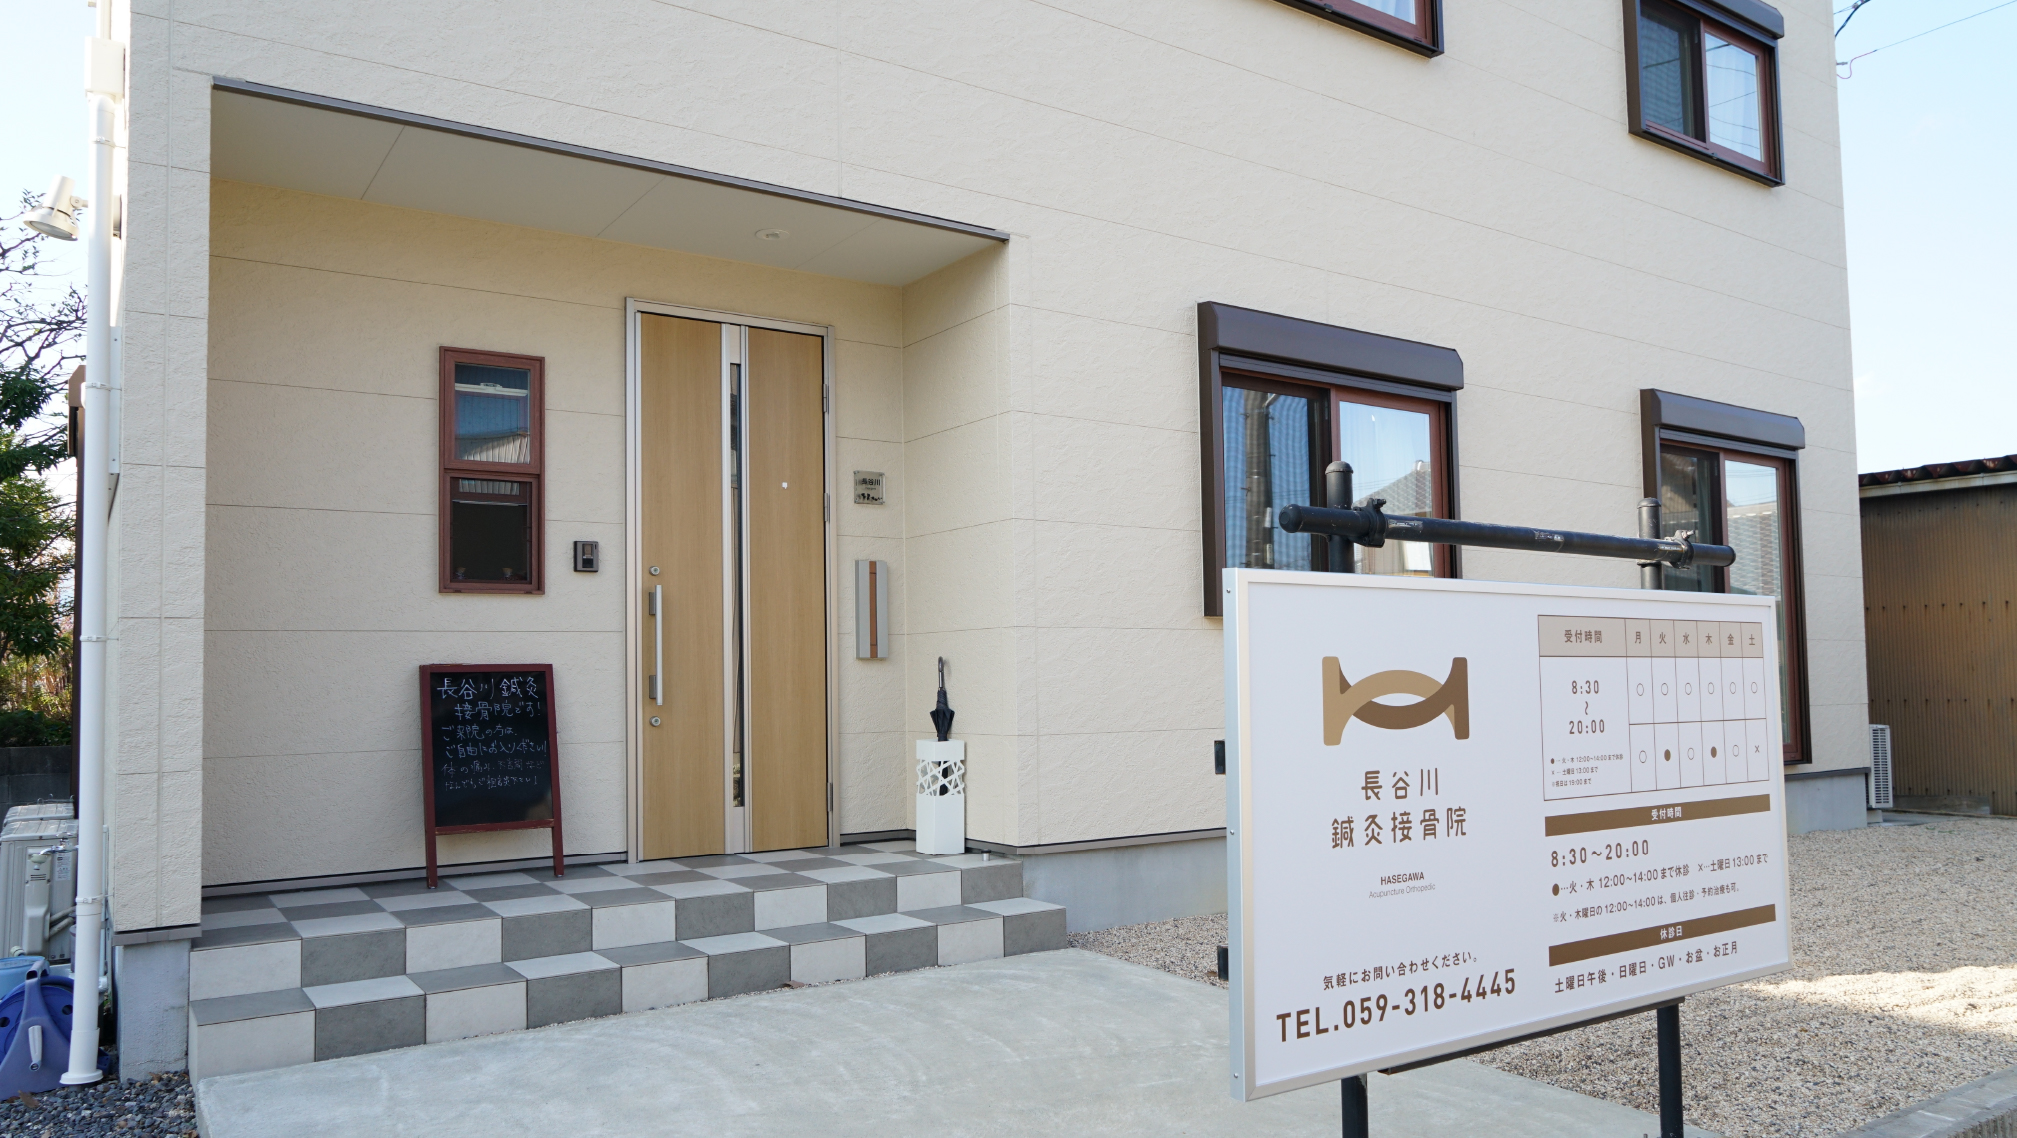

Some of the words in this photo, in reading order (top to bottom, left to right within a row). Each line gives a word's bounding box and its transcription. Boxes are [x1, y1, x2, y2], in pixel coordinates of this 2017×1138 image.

[1565, 630, 1602, 643] 受付時間
[1634, 632, 1642, 644] 月
[1658, 632, 1667, 644] 火
[1682, 633, 1690, 644] 水
[1705, 633, 1713, 644] 木
[1727, 634, 1735, 645] 金
[1748, 634, 1756, 645] 土
[1572, 680, 1599, 694] 8:30
[1569, 719, 1604, 734] 20:00
[1361, 768, 1438, 800] 長谷川
[1651, 807, 1682, 821] 受付時間
[1332, 806, 1466, 849] 鍼灸接骨院
[1551, 840, 1648, 867] 8:30~20:00
[1381, 872, 1424, 885] HASEGAWA
[1369, 888, 1405, 898] Acupuncture
[1406, 884, 1435, 893] Orthopedic
[1660, 926, 1683, 940] 休診日
[1323, 952, 1476, 990] 気軽にお問い合わせください。
